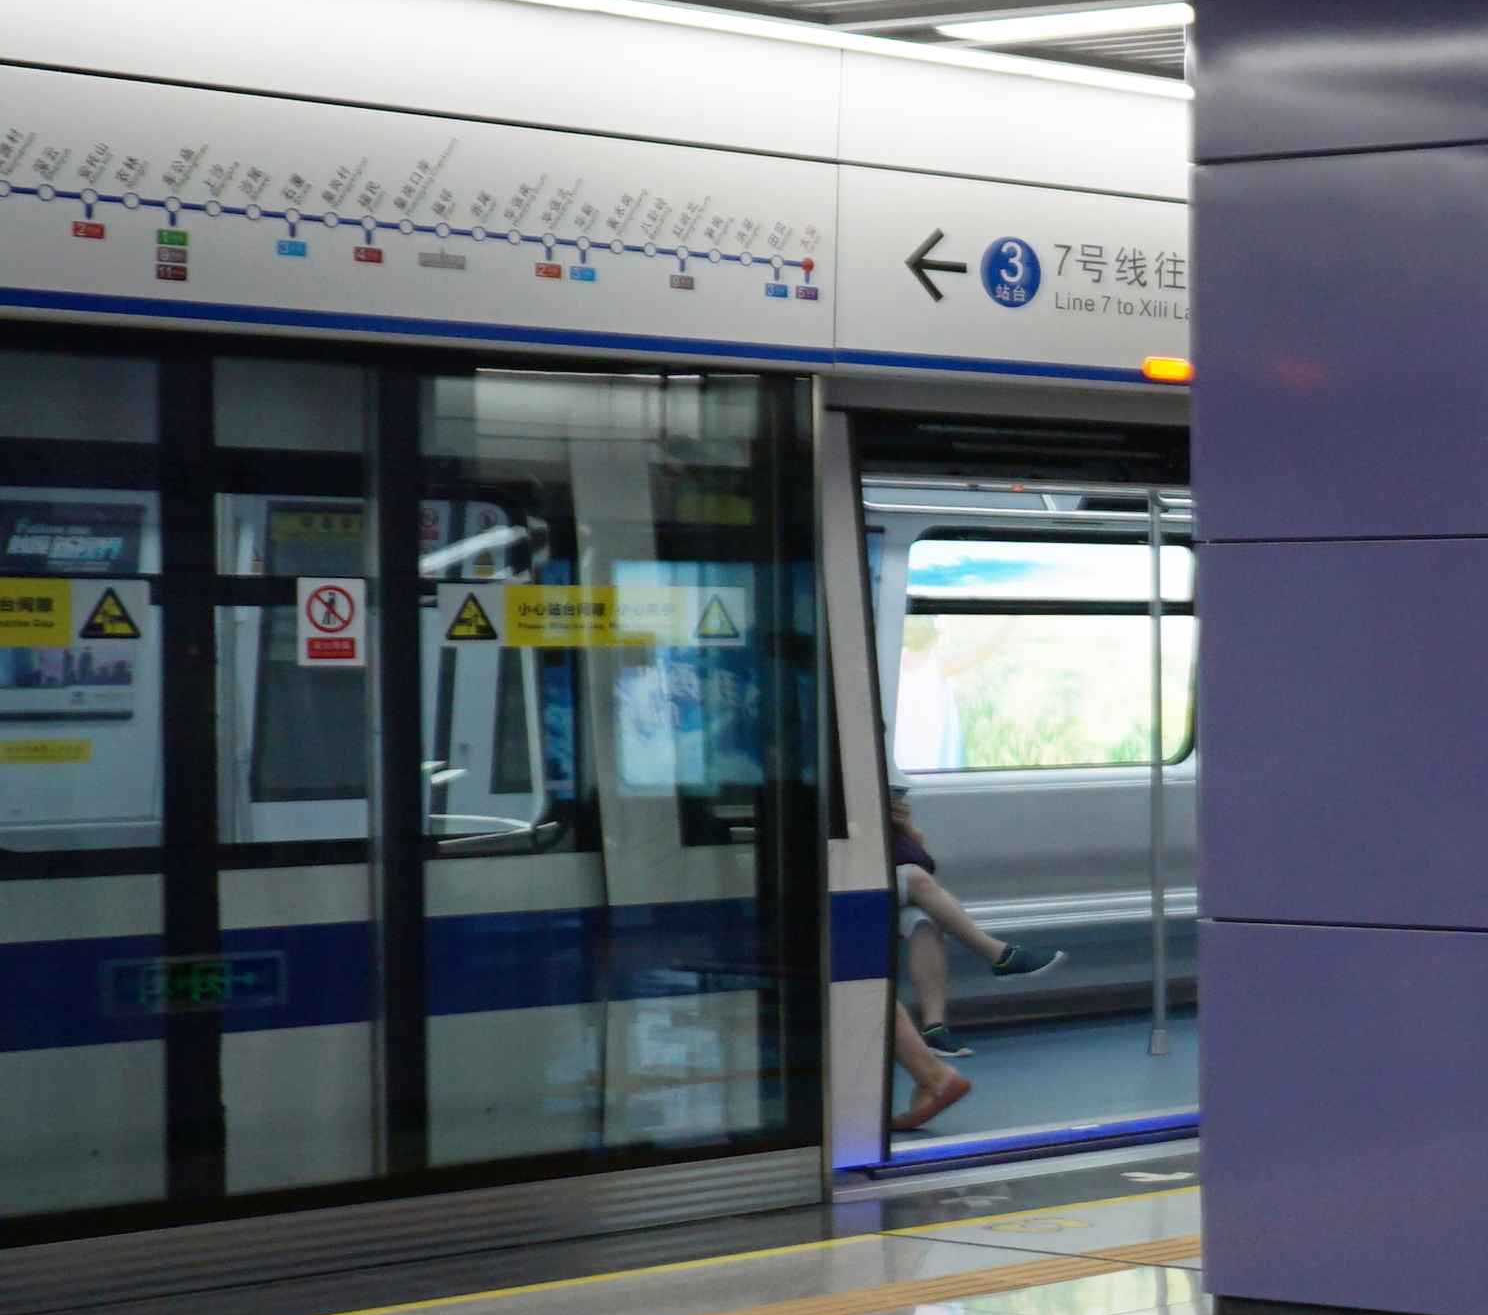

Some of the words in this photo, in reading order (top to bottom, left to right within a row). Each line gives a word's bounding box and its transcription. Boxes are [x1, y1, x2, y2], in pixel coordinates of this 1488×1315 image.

[1000, 241, 1023, 283] 3
[1054, 244, 1186, 290] 7号线往
[995, 285, 1027, 302] 站台
[1055, 292, 1095, 312] Line
[1101, 296, 1111, 314] 7
[1117, 297, 1134, 315] to
[1139, 299, 1168, 319] Xili
